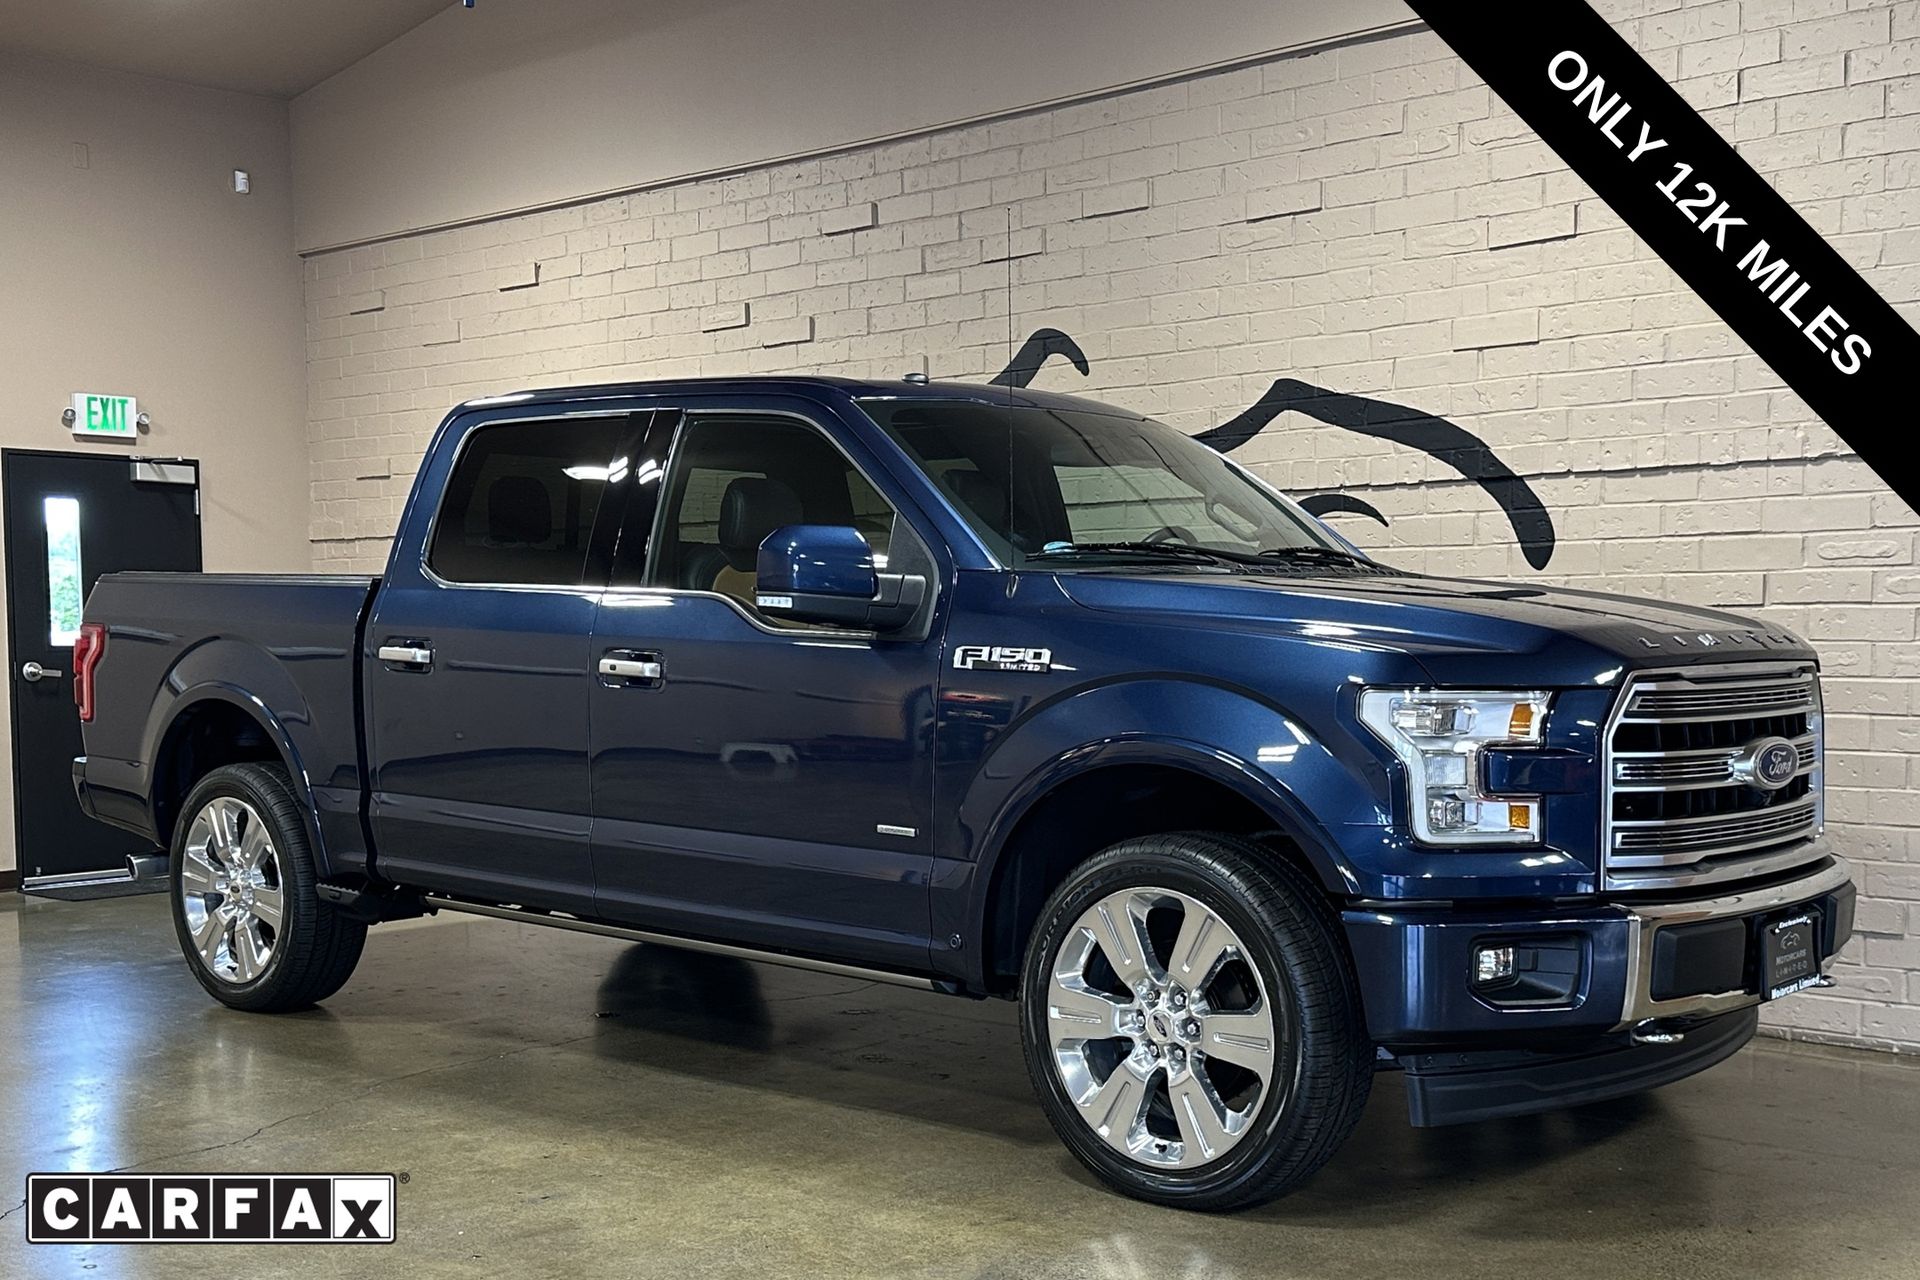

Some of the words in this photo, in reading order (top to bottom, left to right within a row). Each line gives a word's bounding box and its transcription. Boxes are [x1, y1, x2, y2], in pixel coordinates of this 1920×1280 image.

[86, 396, 128, 431] EXIT
[1000, 662, 1041, 672] LIMITED
[1768, 750, 1793, 776] Ford
[1771, 983, 1798, 1000] Motorcars
[1798, 973, 1820, 990] Limited
